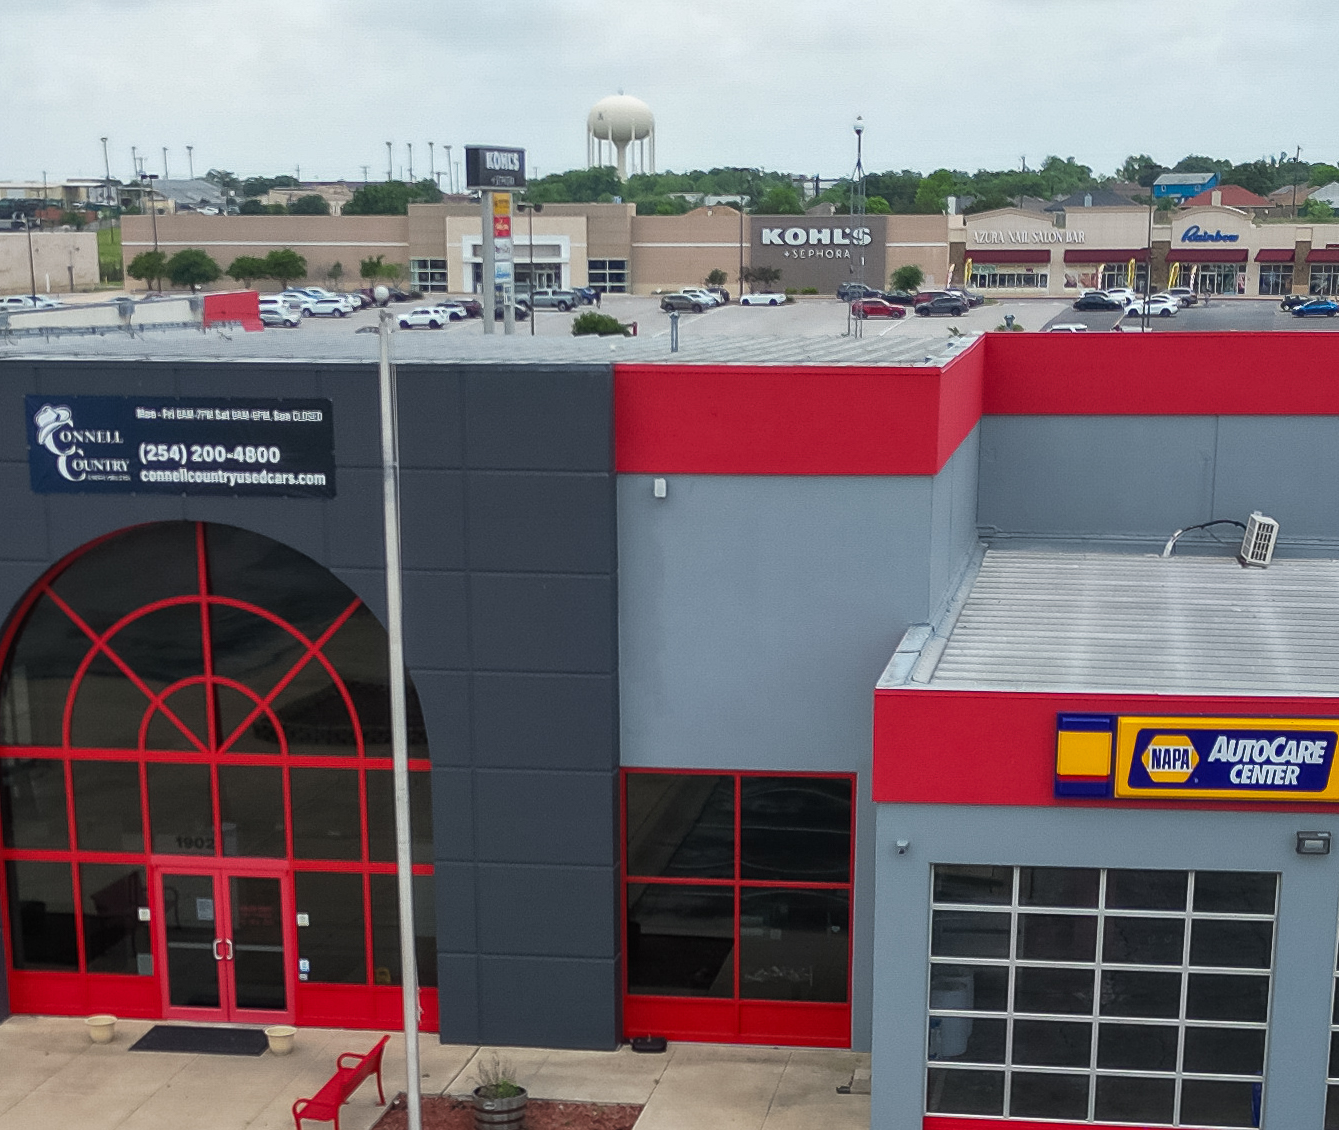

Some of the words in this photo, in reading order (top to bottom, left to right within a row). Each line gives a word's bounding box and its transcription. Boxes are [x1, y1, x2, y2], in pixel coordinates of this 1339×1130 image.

[762, 227, 873, 246] KOHL'S
[974, 231, 1005, 244] AZURA
[1008, 231, 1030, 244] NAIL
[1032, 231, 1063, 244] SALON
[1065, 231, 1086, 244] BAR
[139, 442, 187, 465] (254)
[190, 444, 281, 463] 200-4800
[57, 448, 130, 481] COUNTRY
[140, 467, 326, 486] connellcountryusedcars.com
[1151, 749, 1190, 770] NAPA
[1229, 764, 1300, 785] CENTER
